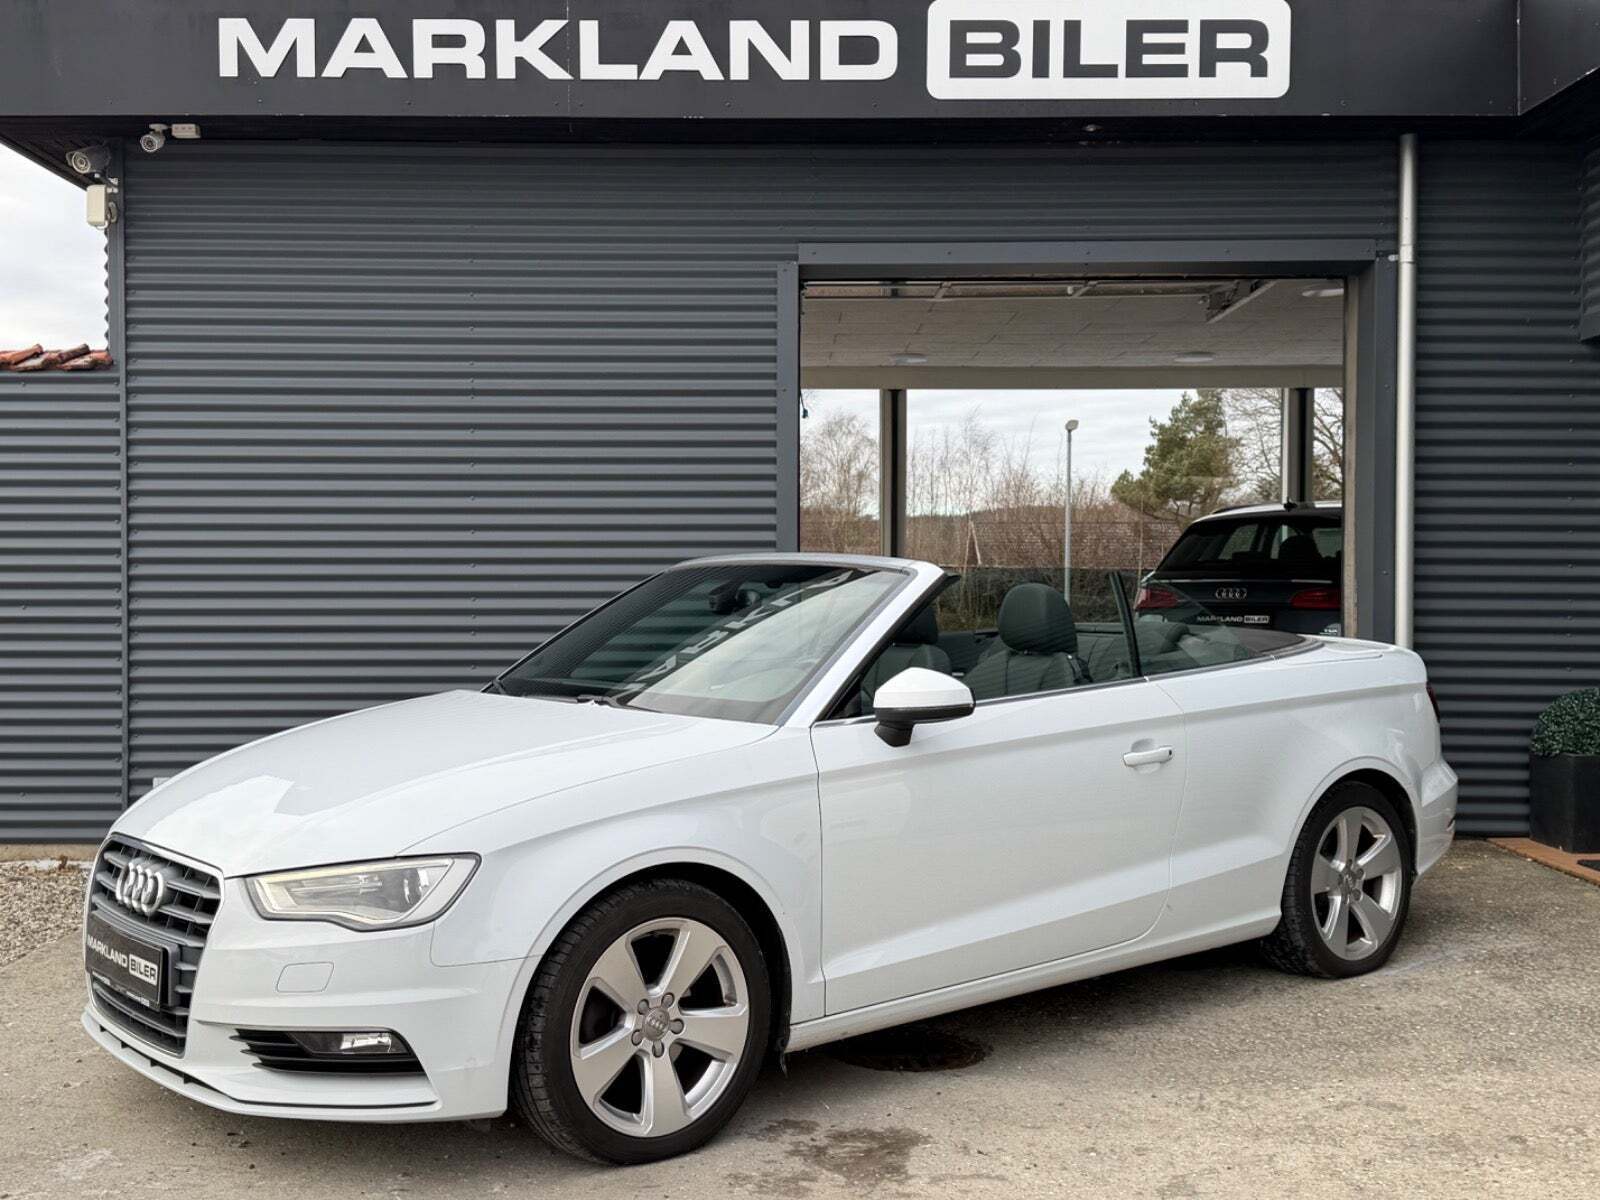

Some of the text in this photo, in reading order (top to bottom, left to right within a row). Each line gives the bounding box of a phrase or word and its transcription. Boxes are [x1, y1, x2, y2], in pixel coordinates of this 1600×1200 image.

[218, 17, 1269, 82] MARKLAND BILER
[87, 934, 128, 968] MARKLAND
[130, 958, 157, 981] BILER
